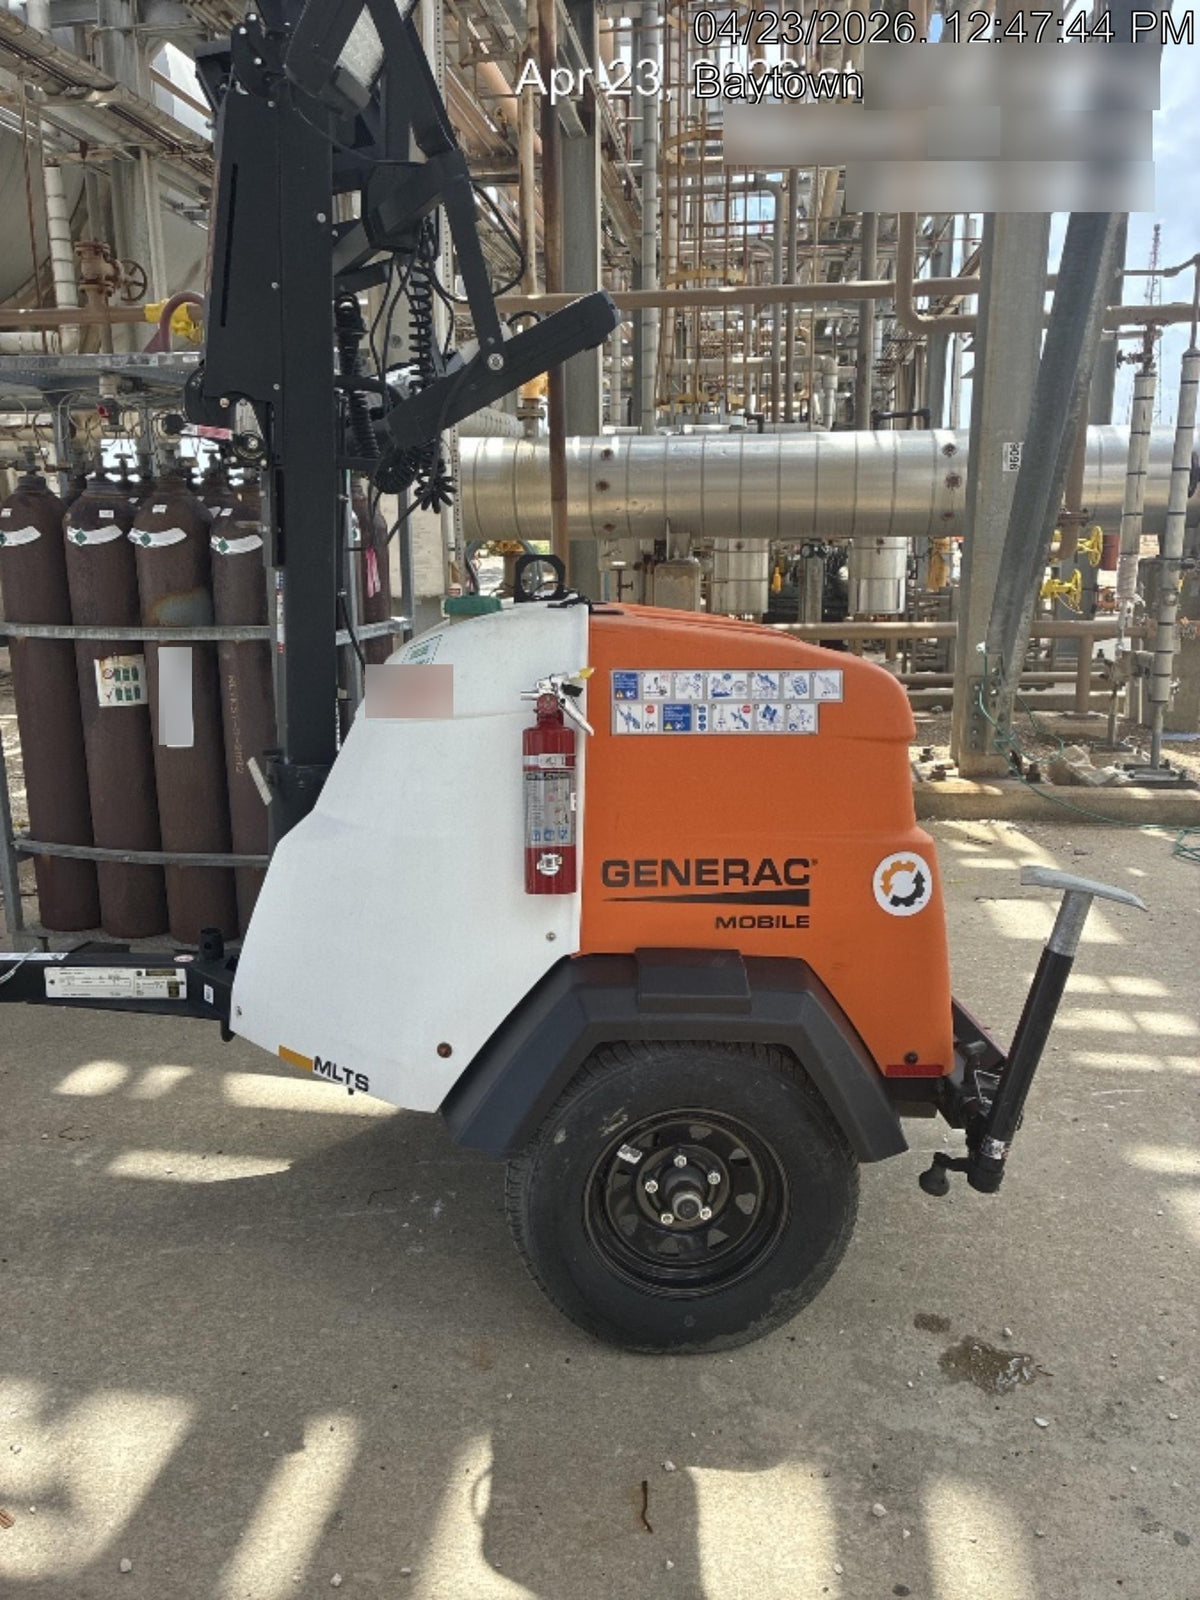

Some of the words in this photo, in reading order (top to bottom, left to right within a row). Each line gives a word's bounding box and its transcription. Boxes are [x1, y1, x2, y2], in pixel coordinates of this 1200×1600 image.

[602, 858, 810, 888] GENERAC
[715, 915, 810, 929] MOBILE
[314, 1055, 369, 1093] MLTS
